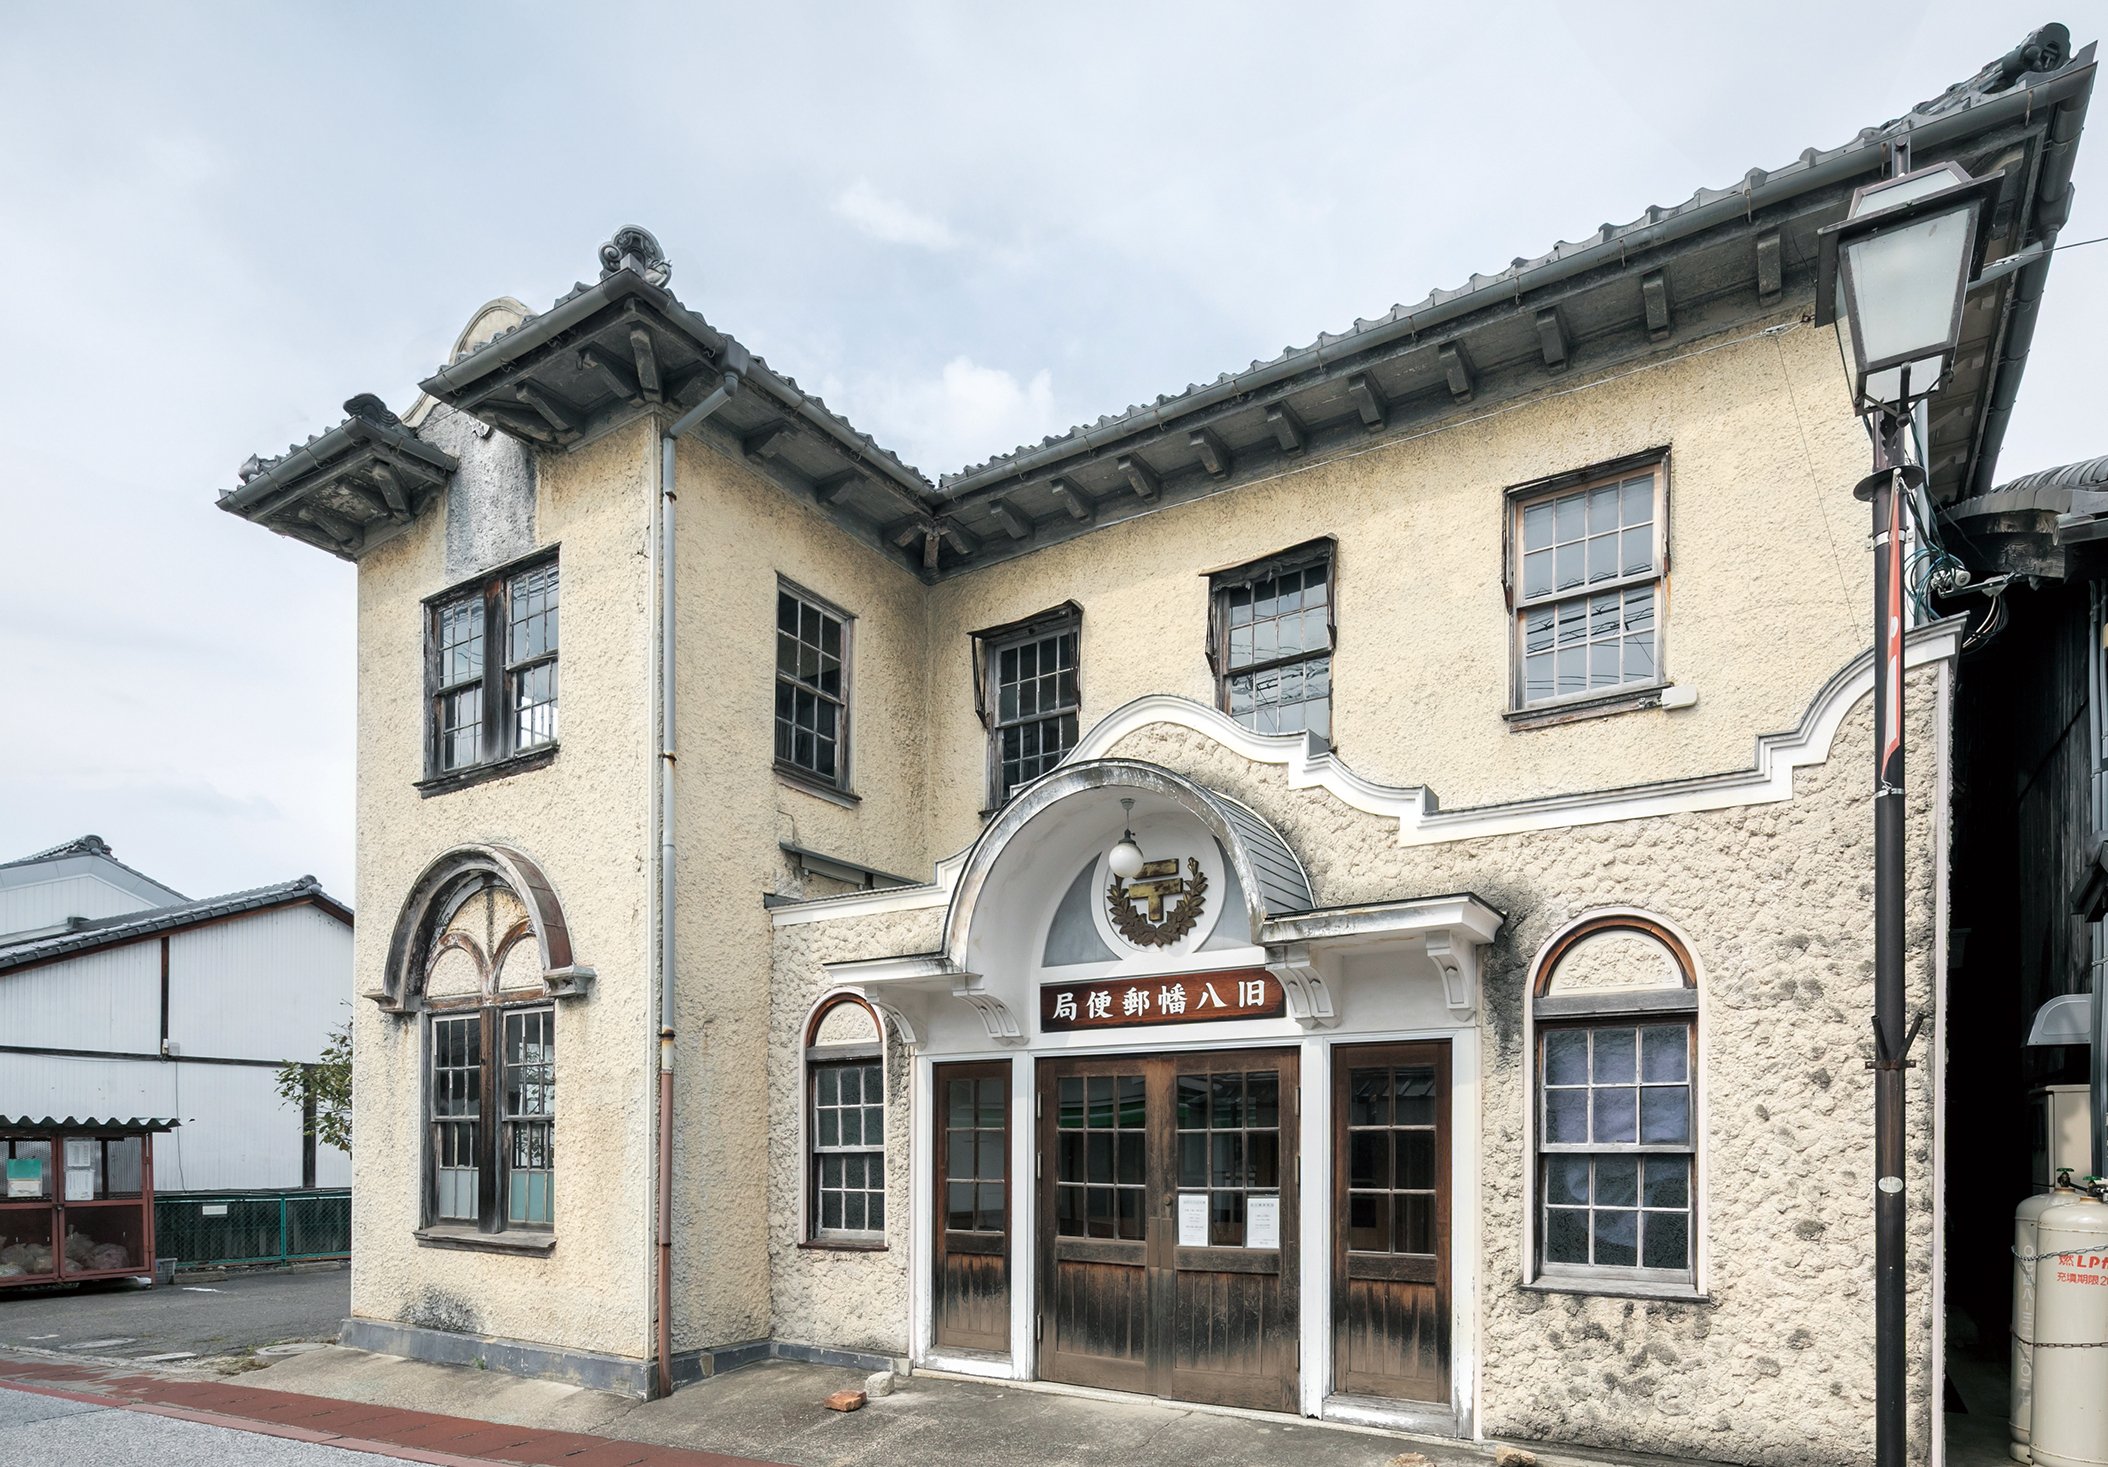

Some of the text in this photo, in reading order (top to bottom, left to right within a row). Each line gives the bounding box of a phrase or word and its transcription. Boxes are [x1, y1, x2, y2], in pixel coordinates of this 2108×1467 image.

[1052, 979, 1265, 1021] 旧八幡郵便局
